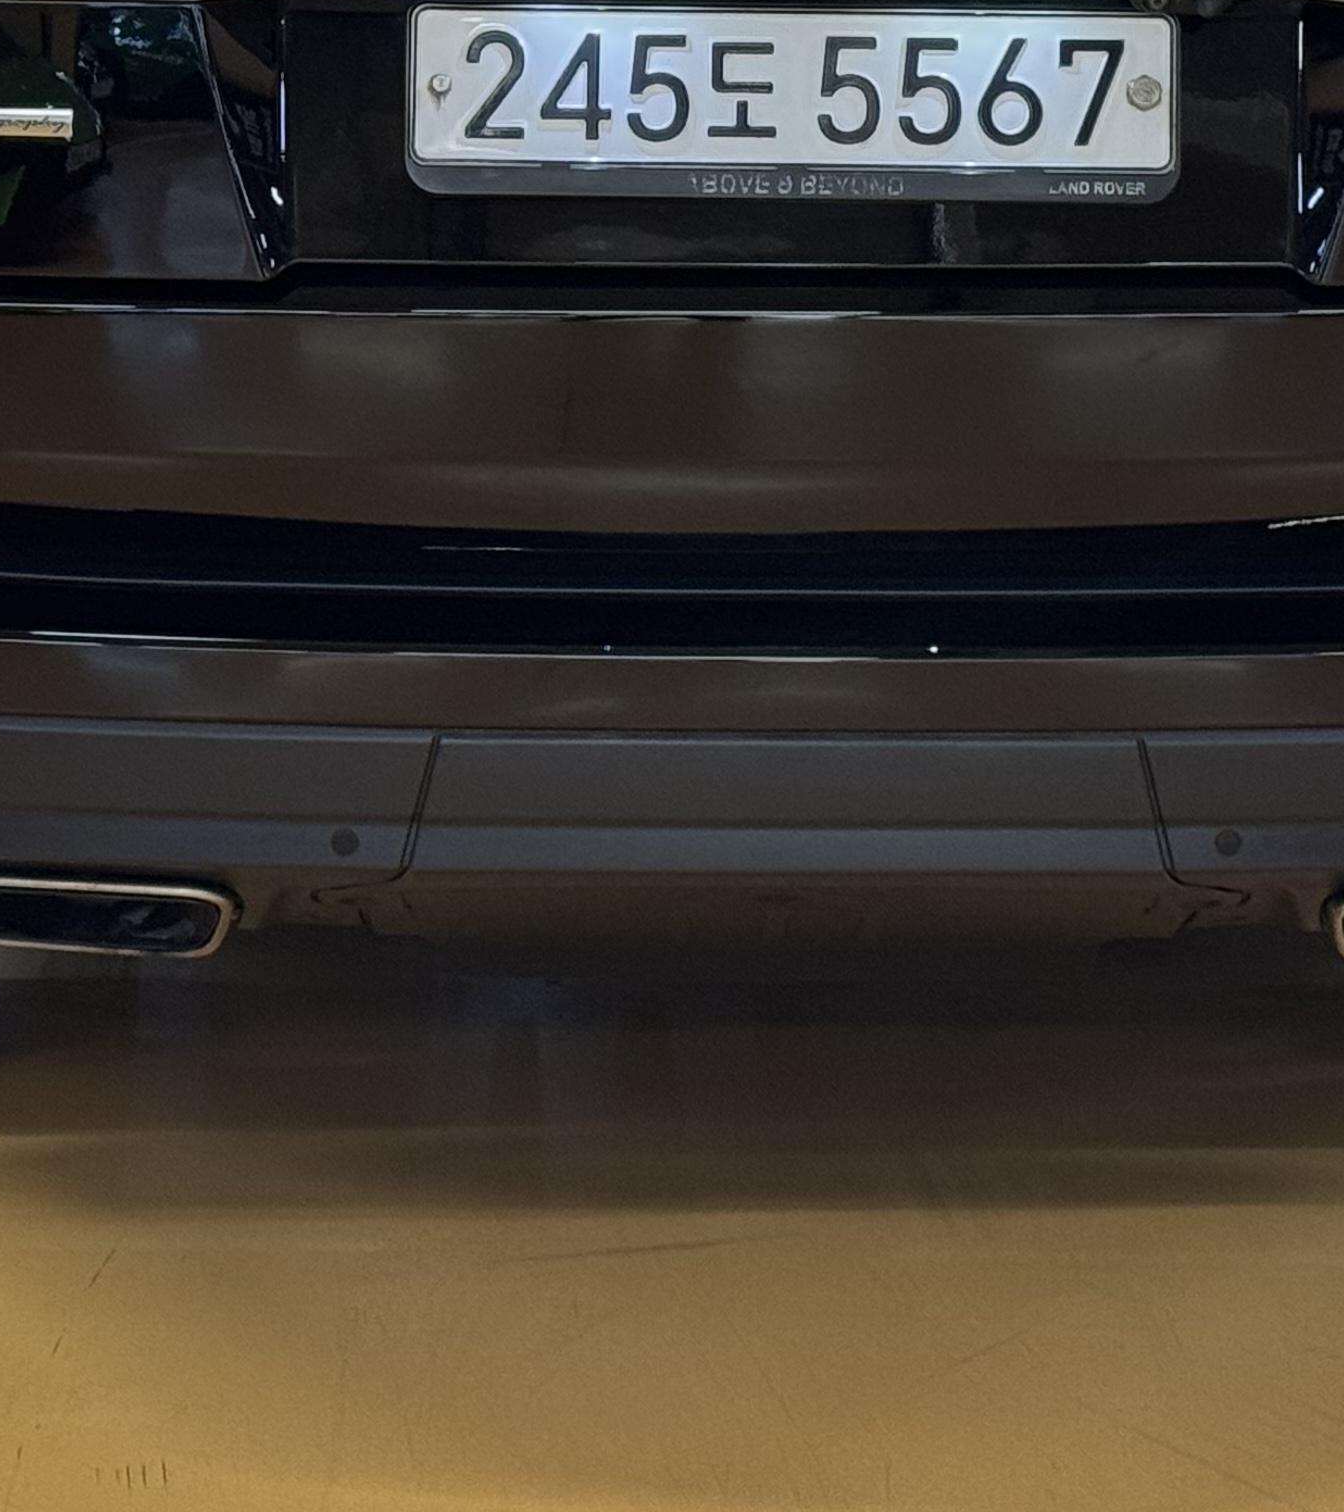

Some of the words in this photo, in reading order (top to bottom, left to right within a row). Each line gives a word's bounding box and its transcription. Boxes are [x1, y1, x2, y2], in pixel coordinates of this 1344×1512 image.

[462, 28, 777, 144] 245도
[816, 35, 1125, 148] 5567
[1049, 180, 1090, 196] LAND
[1094, 181, 1146, 196] ROVER
